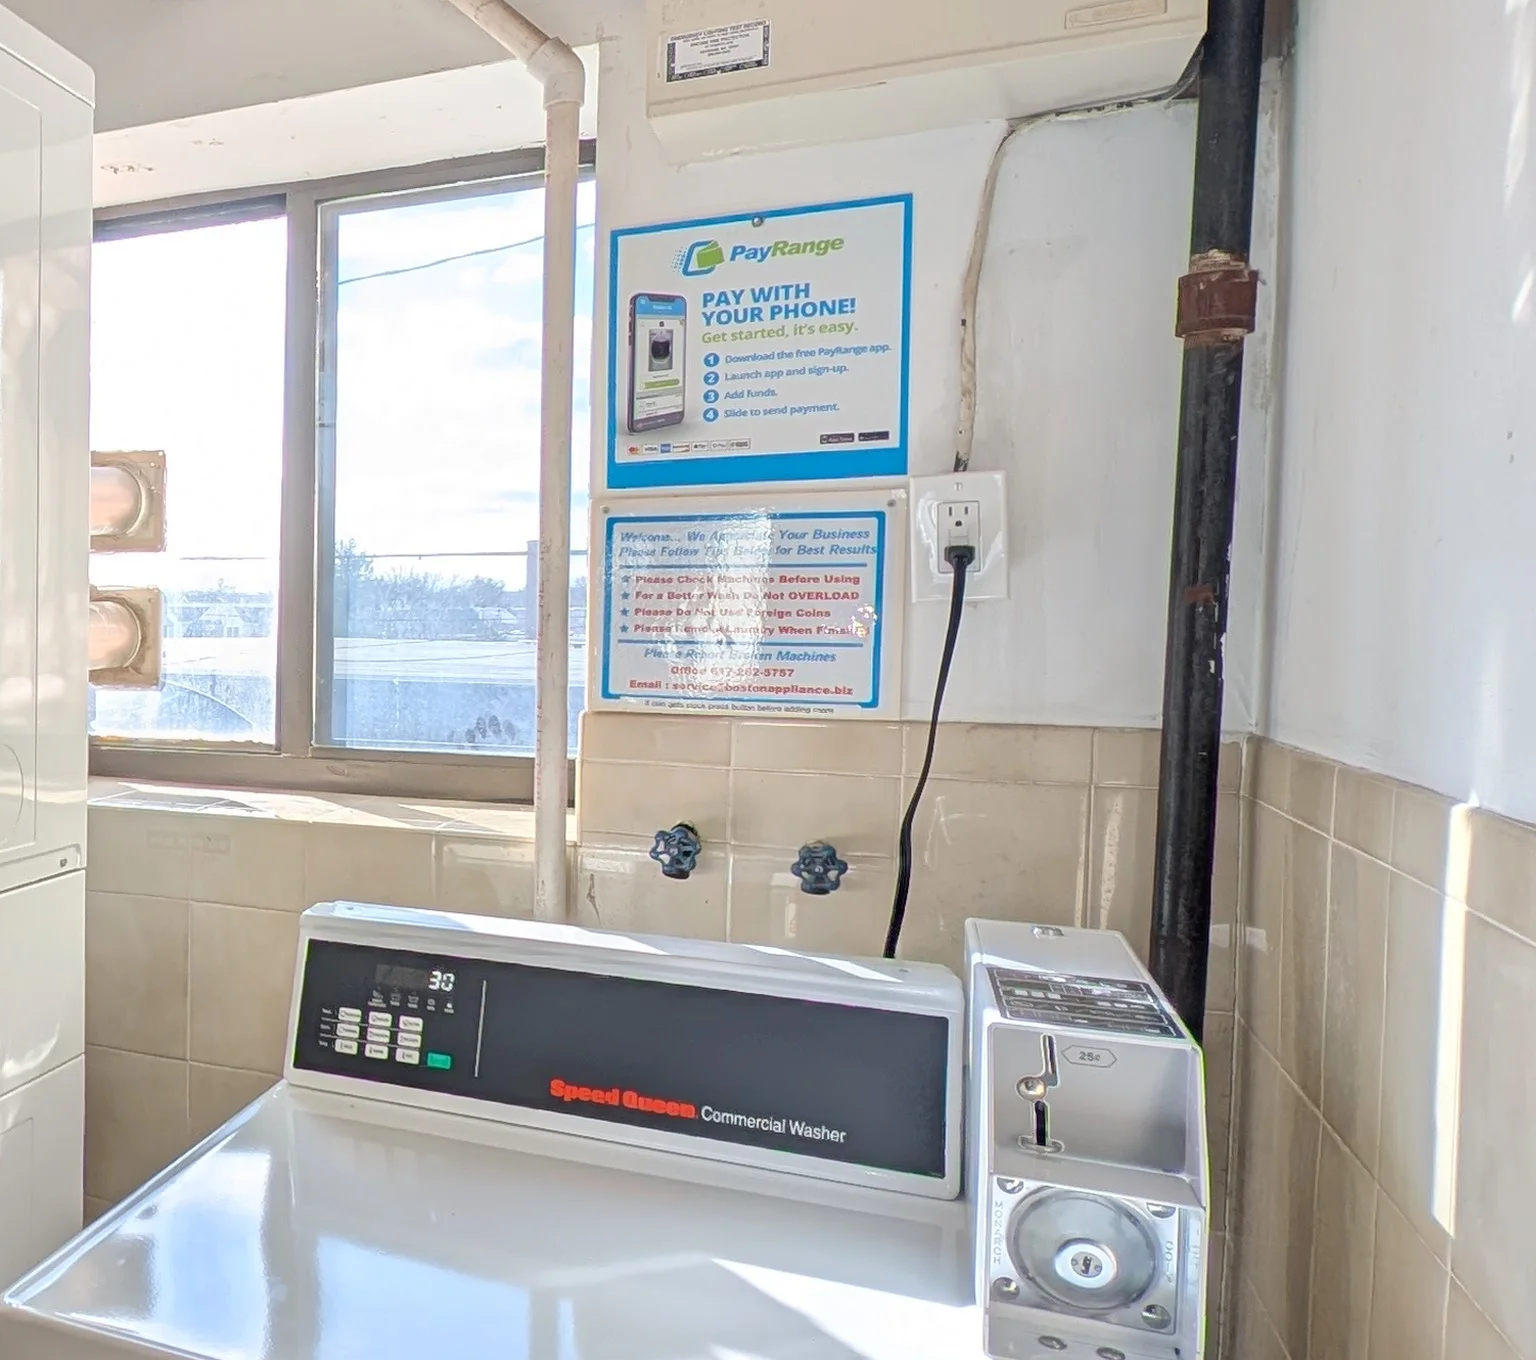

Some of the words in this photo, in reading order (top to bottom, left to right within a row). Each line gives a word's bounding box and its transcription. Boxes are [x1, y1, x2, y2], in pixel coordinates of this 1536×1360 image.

[729, 237, 845, 263] PayRange
[702, 289, 745, 308] PAY
[750, 282, 810, 303] WITH
[702, 307, 764, 327] YOUR
[770, 297, 856, 321] PHONE!
[702, 331, 727, 344] Get
[731, 324, 789, 342] started,
[793, 323, 815, 336] it's
[819, 321, 859, 335] easy.
[725, 351, 776, 365] Download
[777, 349, 795, 360] the
[795, 347, 816, 359] free
[818, 345, 868, 358] PayRange
[869, 343, 892, 354] app.
[724, 370, 762, 381] Launch
[764, 368, 784, 380] app
[785, 366, 806, 377] and
[808, 364, 850, 377] sign-up.
[724, 390, 744, 400] Add
[746, 388, 779, 399] funds.
[724, 408, 748, 418] Slide
[750, 408, 761, 417] to
[763, 406, 788, 416] send
[789, 403, 840, 416] payment.
[779, 529, 809, 540] Your
[812, 529, 870, 540] Business
[618, 547, 656, 557] Please
[660, 545, 700, 557] Follow
[775, 544, 793, 556] for
[796, 544, 825, 556] Best
[829, 544, 877, 556] Results
[635, 575, 673, 584] Please
[677, 575, 714, 584] Check
[779, 575, 821, 584] Before
[824, 575, 861, 585] Using
[635, 591, 654, 600] For
[764, 591, 785, 600] Not
[788, 591, 860, 600] OVERLOAD
[634, 607, 673, 617] Please
[676, 608, 691, 616] Do
[796, 609, 832, 618] Coins
[633, 624, 672, 634] Please
[779, 626, 812, 635] When
[776, 651, 837, 662] Machines
[629, 680, 662, 689] Email
[428, 970, 456, 992] 30
[550, 1078, 619, 1106] Speed
[623, 1090, 696, 1119] Queen
[701, 1105, 786, 1134] Commercial
[788, 1119, 847, 1143] Washer
